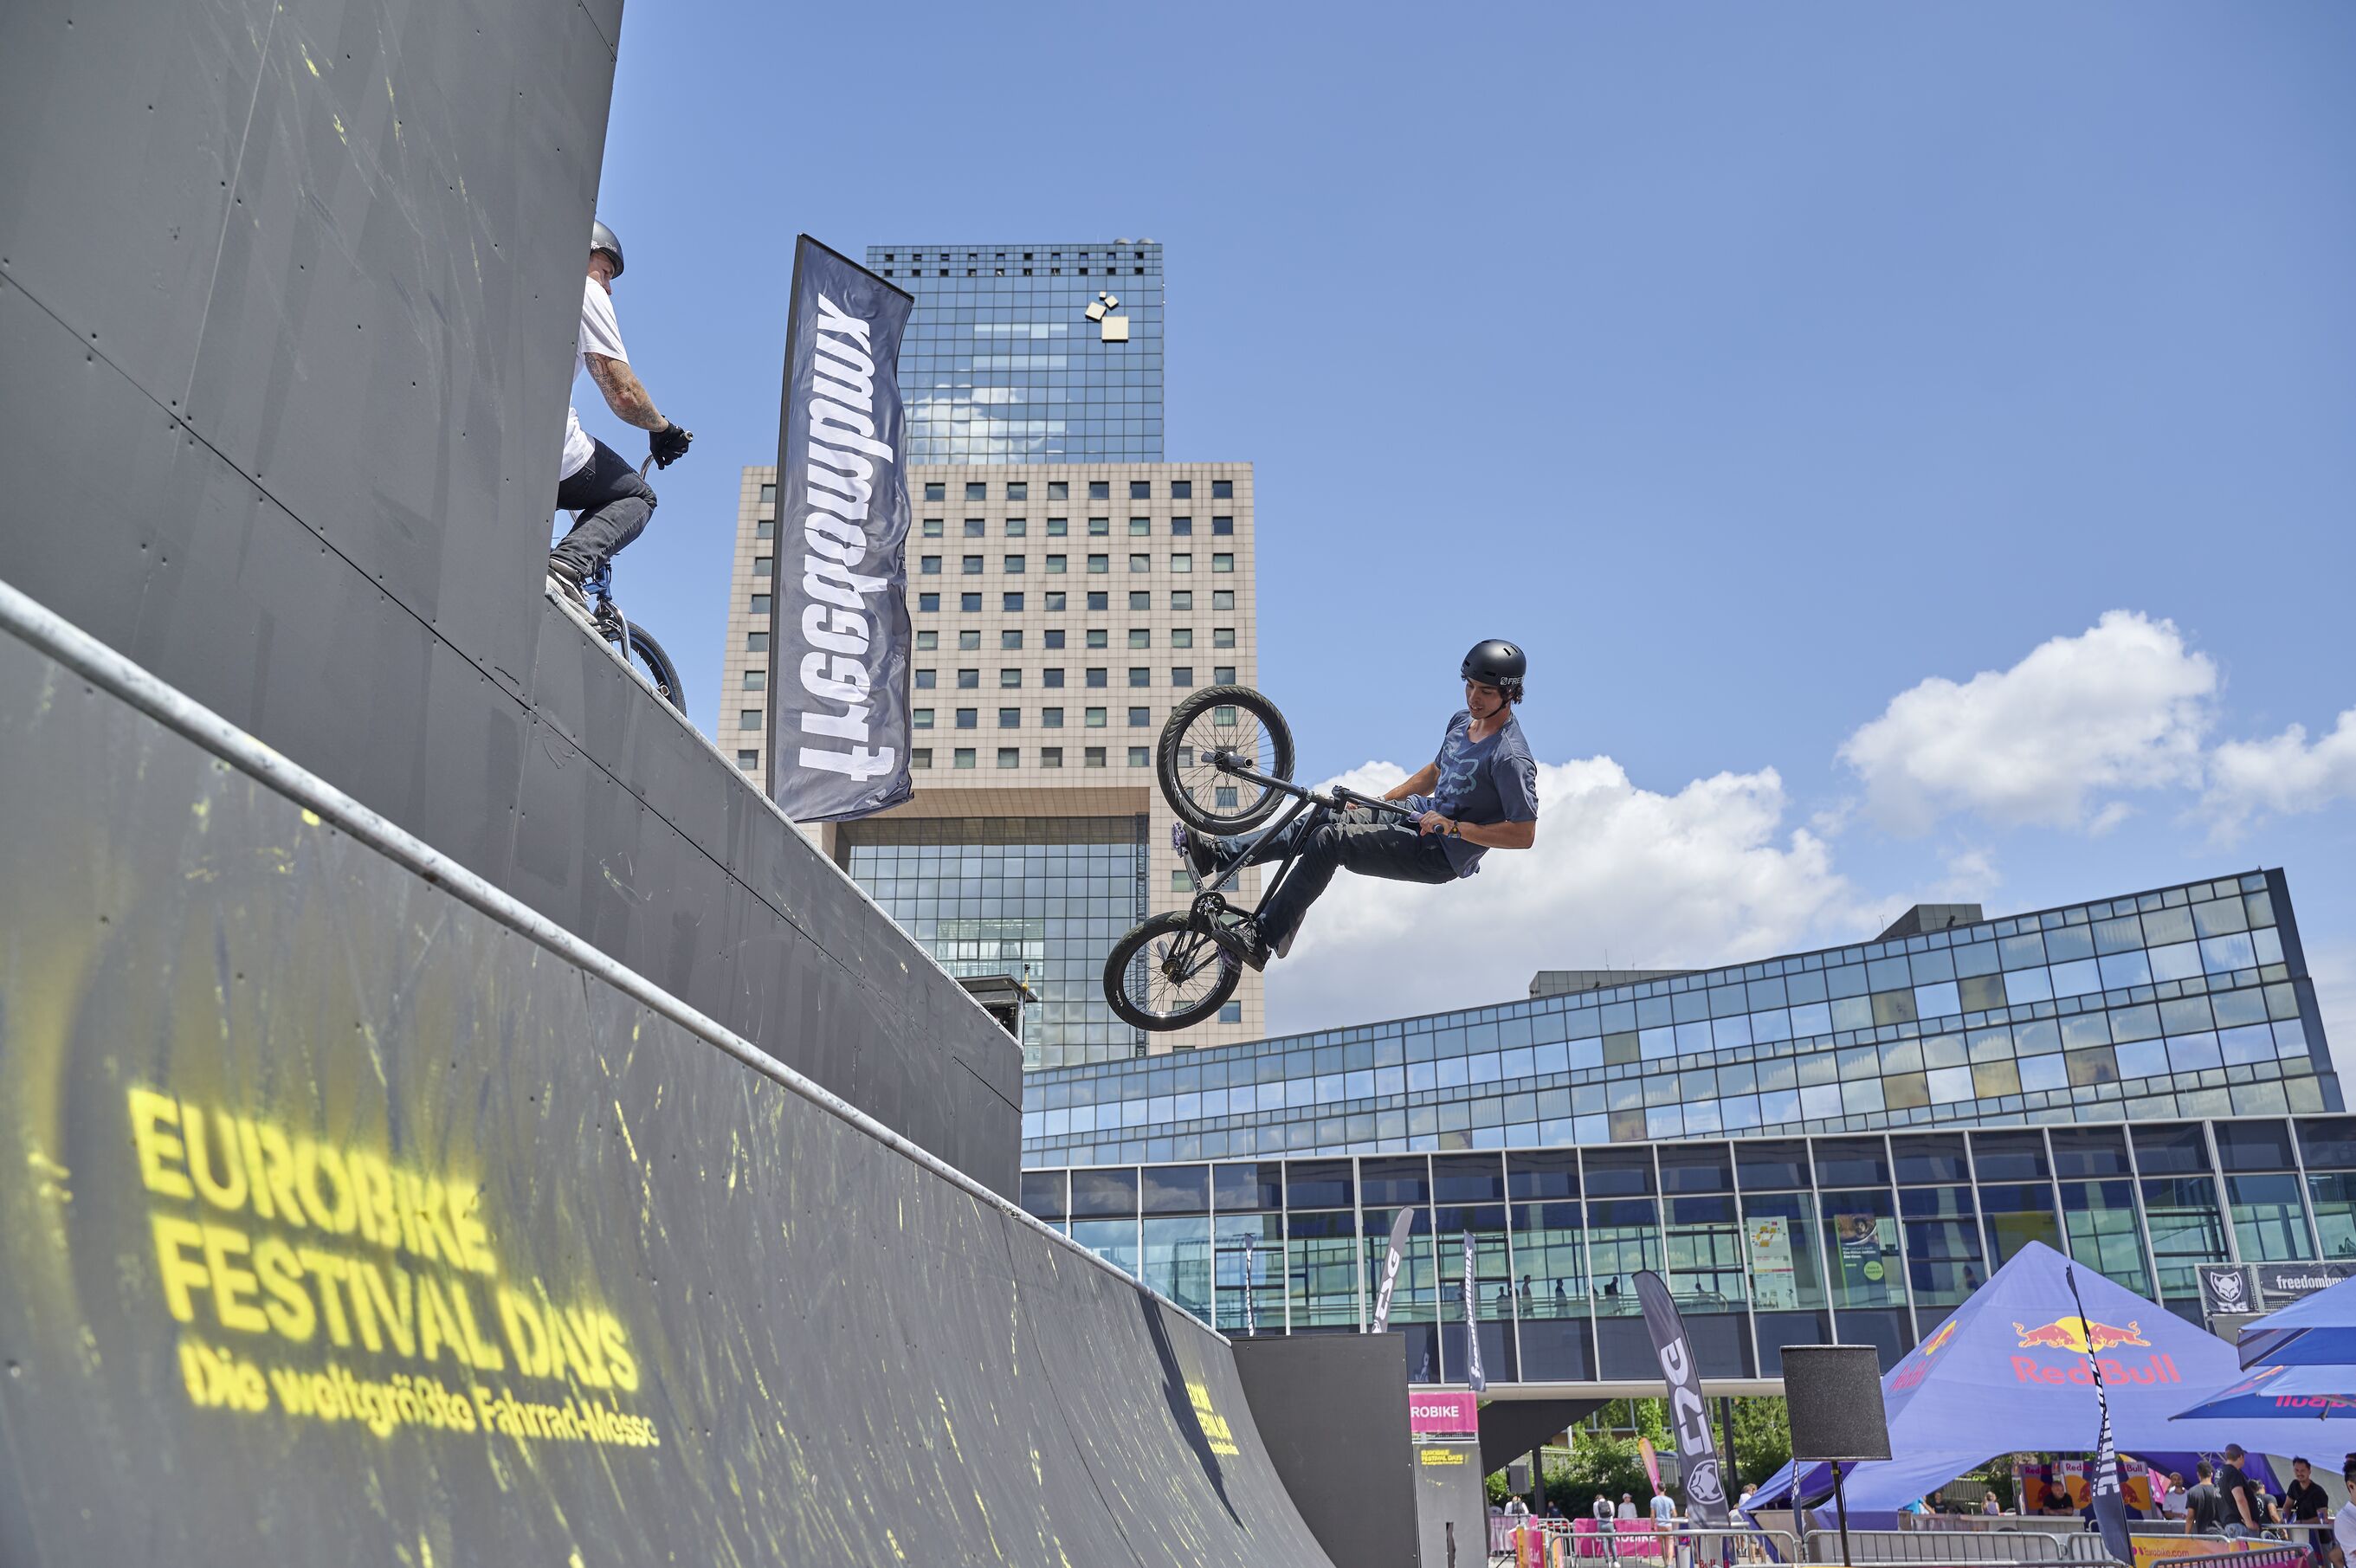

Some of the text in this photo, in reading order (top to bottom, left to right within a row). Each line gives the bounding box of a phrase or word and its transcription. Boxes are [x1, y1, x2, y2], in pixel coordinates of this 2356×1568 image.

[129, 1087, 497, 1275] EUROBIKE
[152, 1215, 641, 1392] FESTIVAL DAYS
[178, 1340, 269, 1413] Die
[270, 1364, 477, 1440] weltgrößte
[2010, 1353, 2182, 1385] Red Bull
[2066, 1462, 2082, 1471] Red
